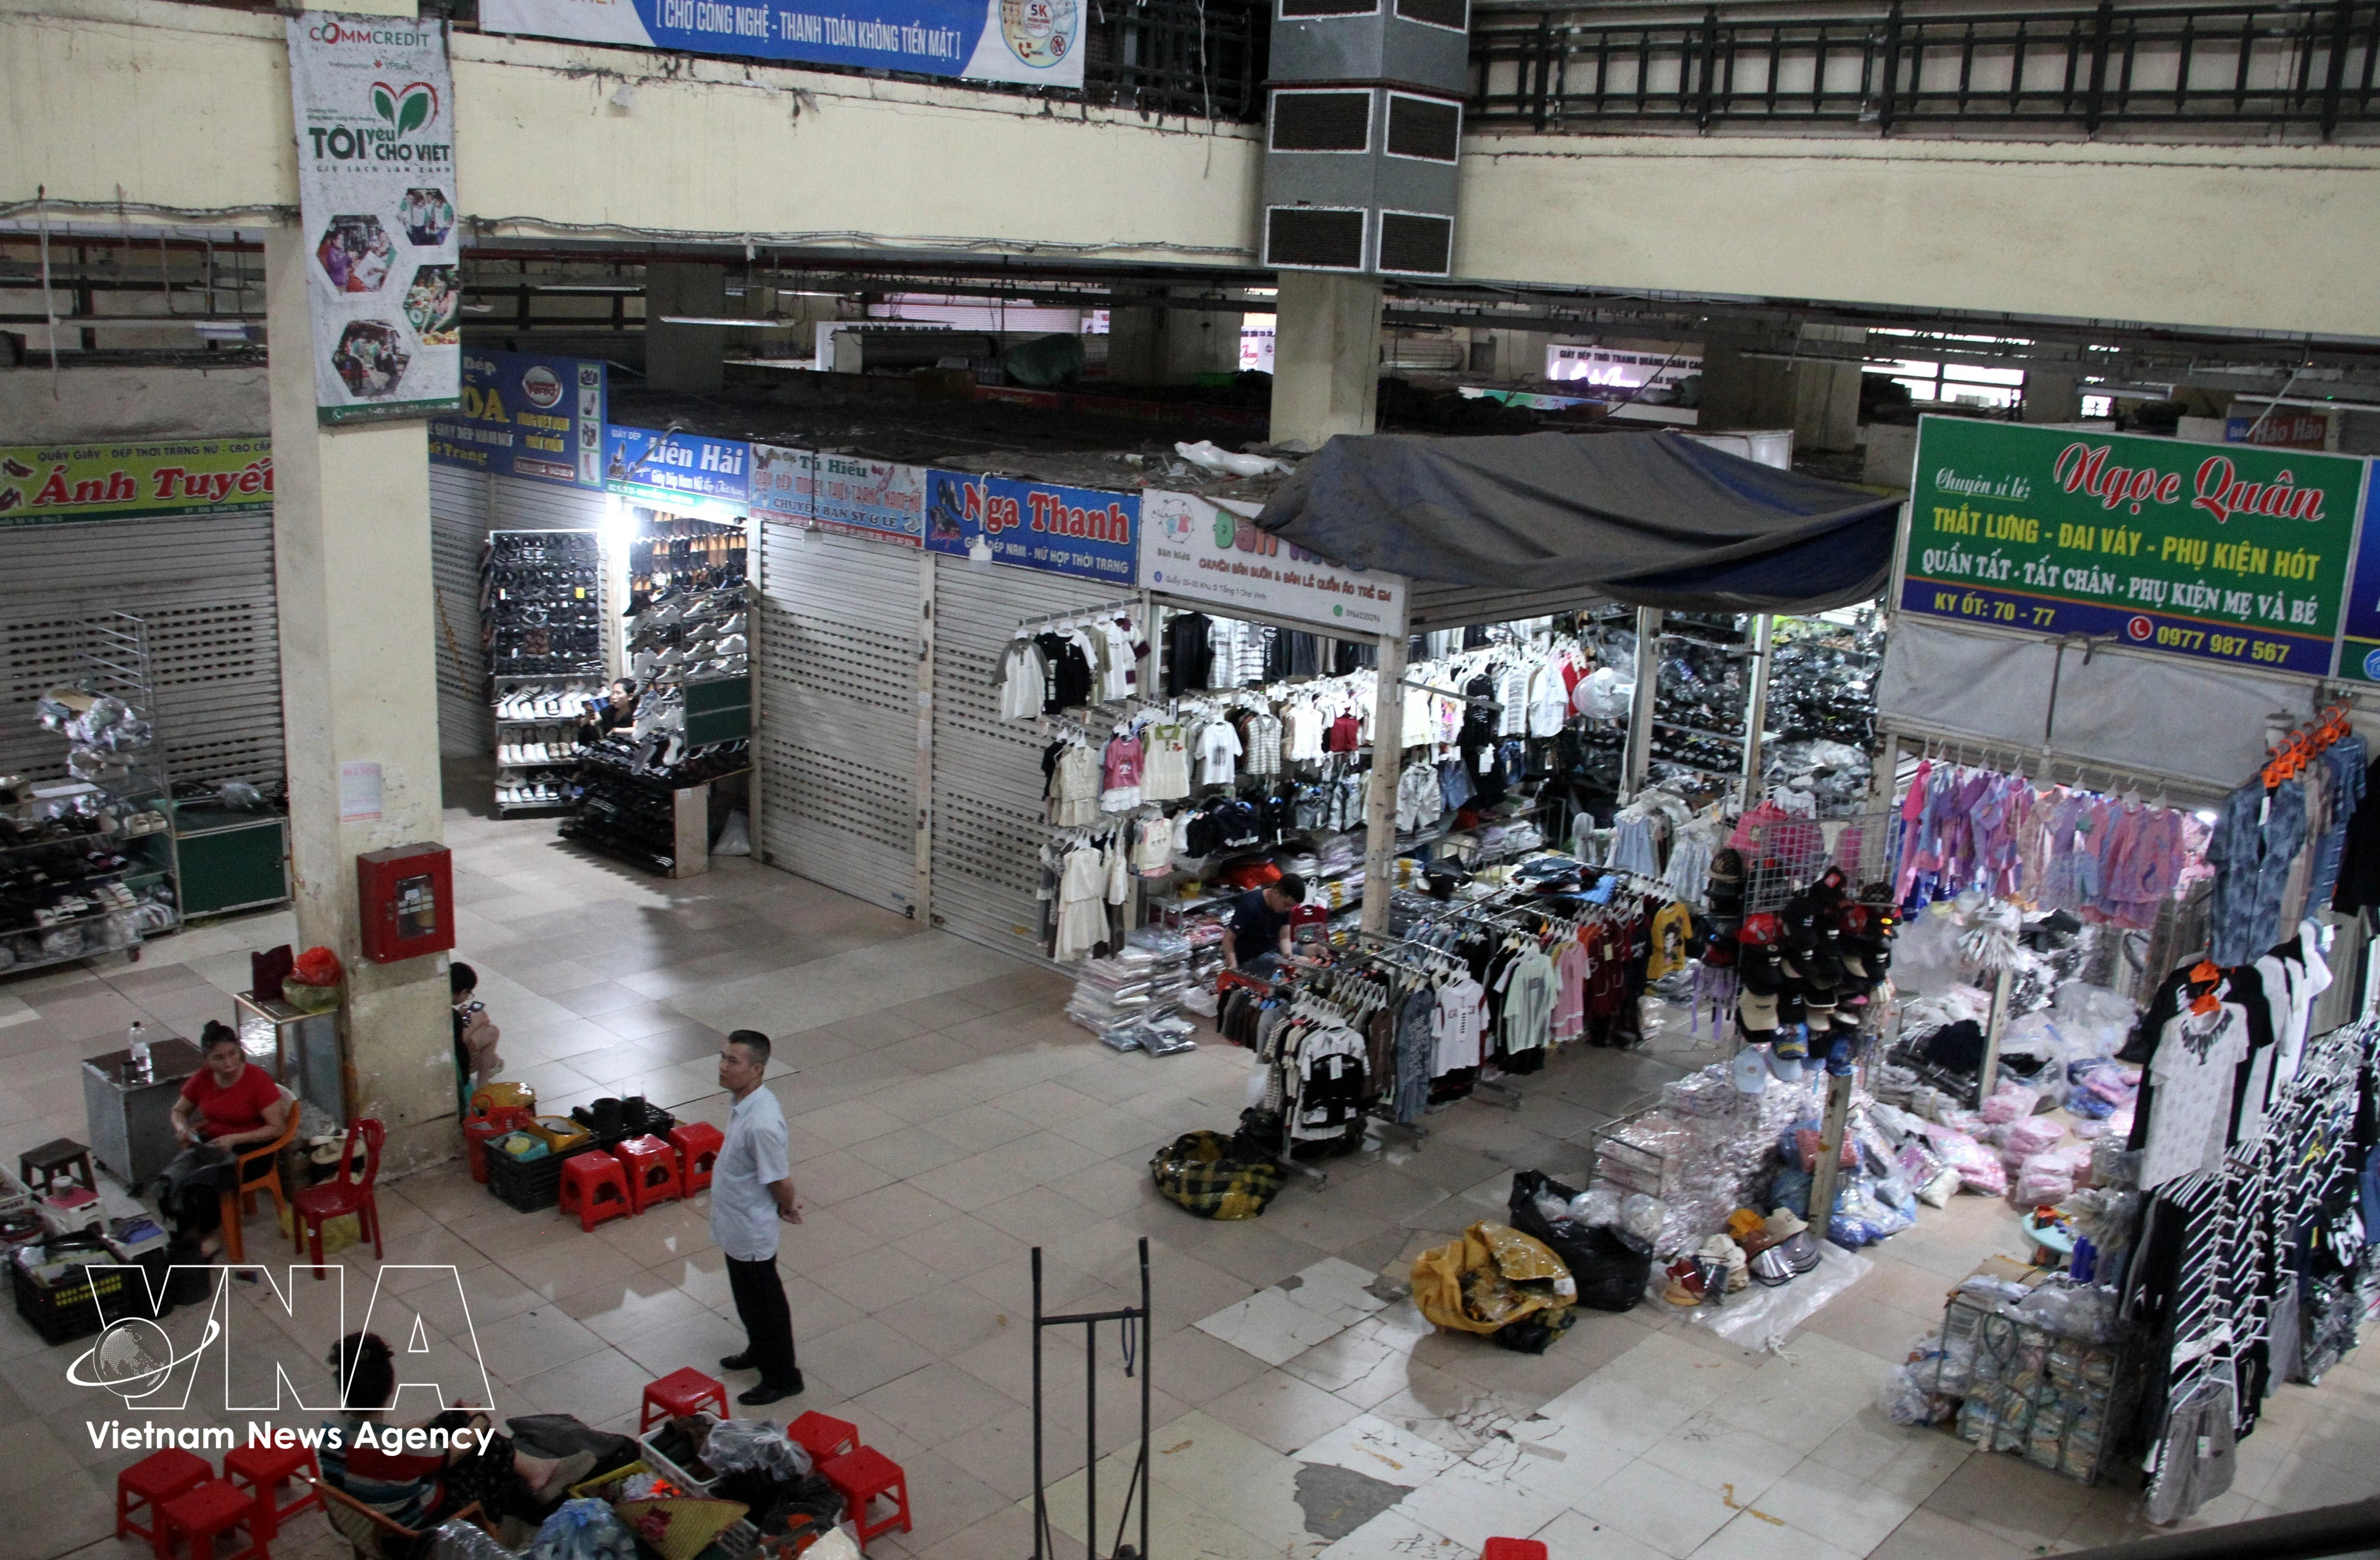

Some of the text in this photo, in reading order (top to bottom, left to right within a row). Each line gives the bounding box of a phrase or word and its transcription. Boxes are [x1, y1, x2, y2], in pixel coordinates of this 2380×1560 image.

[1031, 4, 1048, 17] 5K
[310, 22, 431, 47] COMMCREDIT
[665, 0, 693, 34] CHỢ
[696, 0, 732, 33] CÔNG
[736, 4, 769, 43] NGHỆ
[779, 11, 821, 44] THANH
[824, 14, 856, 47] TOÁN
[858, 18, 898, 52] KHÔNG
[901, 19, 926, 55] TIỀN
[928, 26, 954, 62] MẶT
[309, 124, 396, 160] TÔI yêu
[112, 447, 132, 458] DÉP
[135, 445, 161, 457] THỜI
[164, 446, 200, 455] TRANG
[204, 443, 219, 454] NỮ
[230, 444, 250, 453] CAO
[646, 436, 694, 468] Liên
[700, 444, 744, 475] Hải
[828, 459, 867, 478] Hiếu
[31, 464, 137, 506] Ánh
[1935, 467, 1992, 497] Chuyên
[2053, 442, 2326, 525] Ngọc Quân
[774, 498, 820, 514] CHUYÊN
[823, 504, 848, 518] BÁN
[870, 513, 879, 524] &
[962, 482, 1021, 534] Nga
[1027, 490, 1130, 545] Thanh
[1006, 543, 1026, 557] NAM
[1050, 551, 1070, 567] HỢP
[1096, 557, 1129, 574] TRANG
[1933, 502, 1982, 537] THẮT
[1985, 513, 2040, 544] LƯNG
[2058, 523, 2095, 551] ĐAI
[2101, 525, 2142, 556] VÁY
[2161, 536, 2209, 571] PHỤ
[2212, 540, 2269, 577] KIỆN
[2273, 548, 2321, 581] HÓT
[1199, 557, 1230, 572] CHUYÊN
[1232, 562, 1248, 576] BÁN
[1250, 566, 1272, 580] BUÔN
[1283, 571, 1301, 585] BÁN
[1342, 581, 1354, 595] ÁO
[1378, 589, 1392, 602] EM
[1976, 547, 2012, 581] TẤT
[2023, 554, 2060, 588] TẤT
[2062, 564, 2117, 595] CHÂN
[2127, 576, 2170, 609] PHỤ
[2171, 579, 2222, 615] KIỆN
[2222, 589, 2254, 622] MẸ
[2257, 590, 2286, 621] VÀ
[2289, 594, 2319, 626] BÉ
[1934, 592, 1958, 612] KY
[1961, 591, 1989, 617] ỐT:
[1993, 601, 2016, 621] 70
[2032, 607, 2056, 628] 77
[2156, 625, 2291, 664] 0977 987 567
